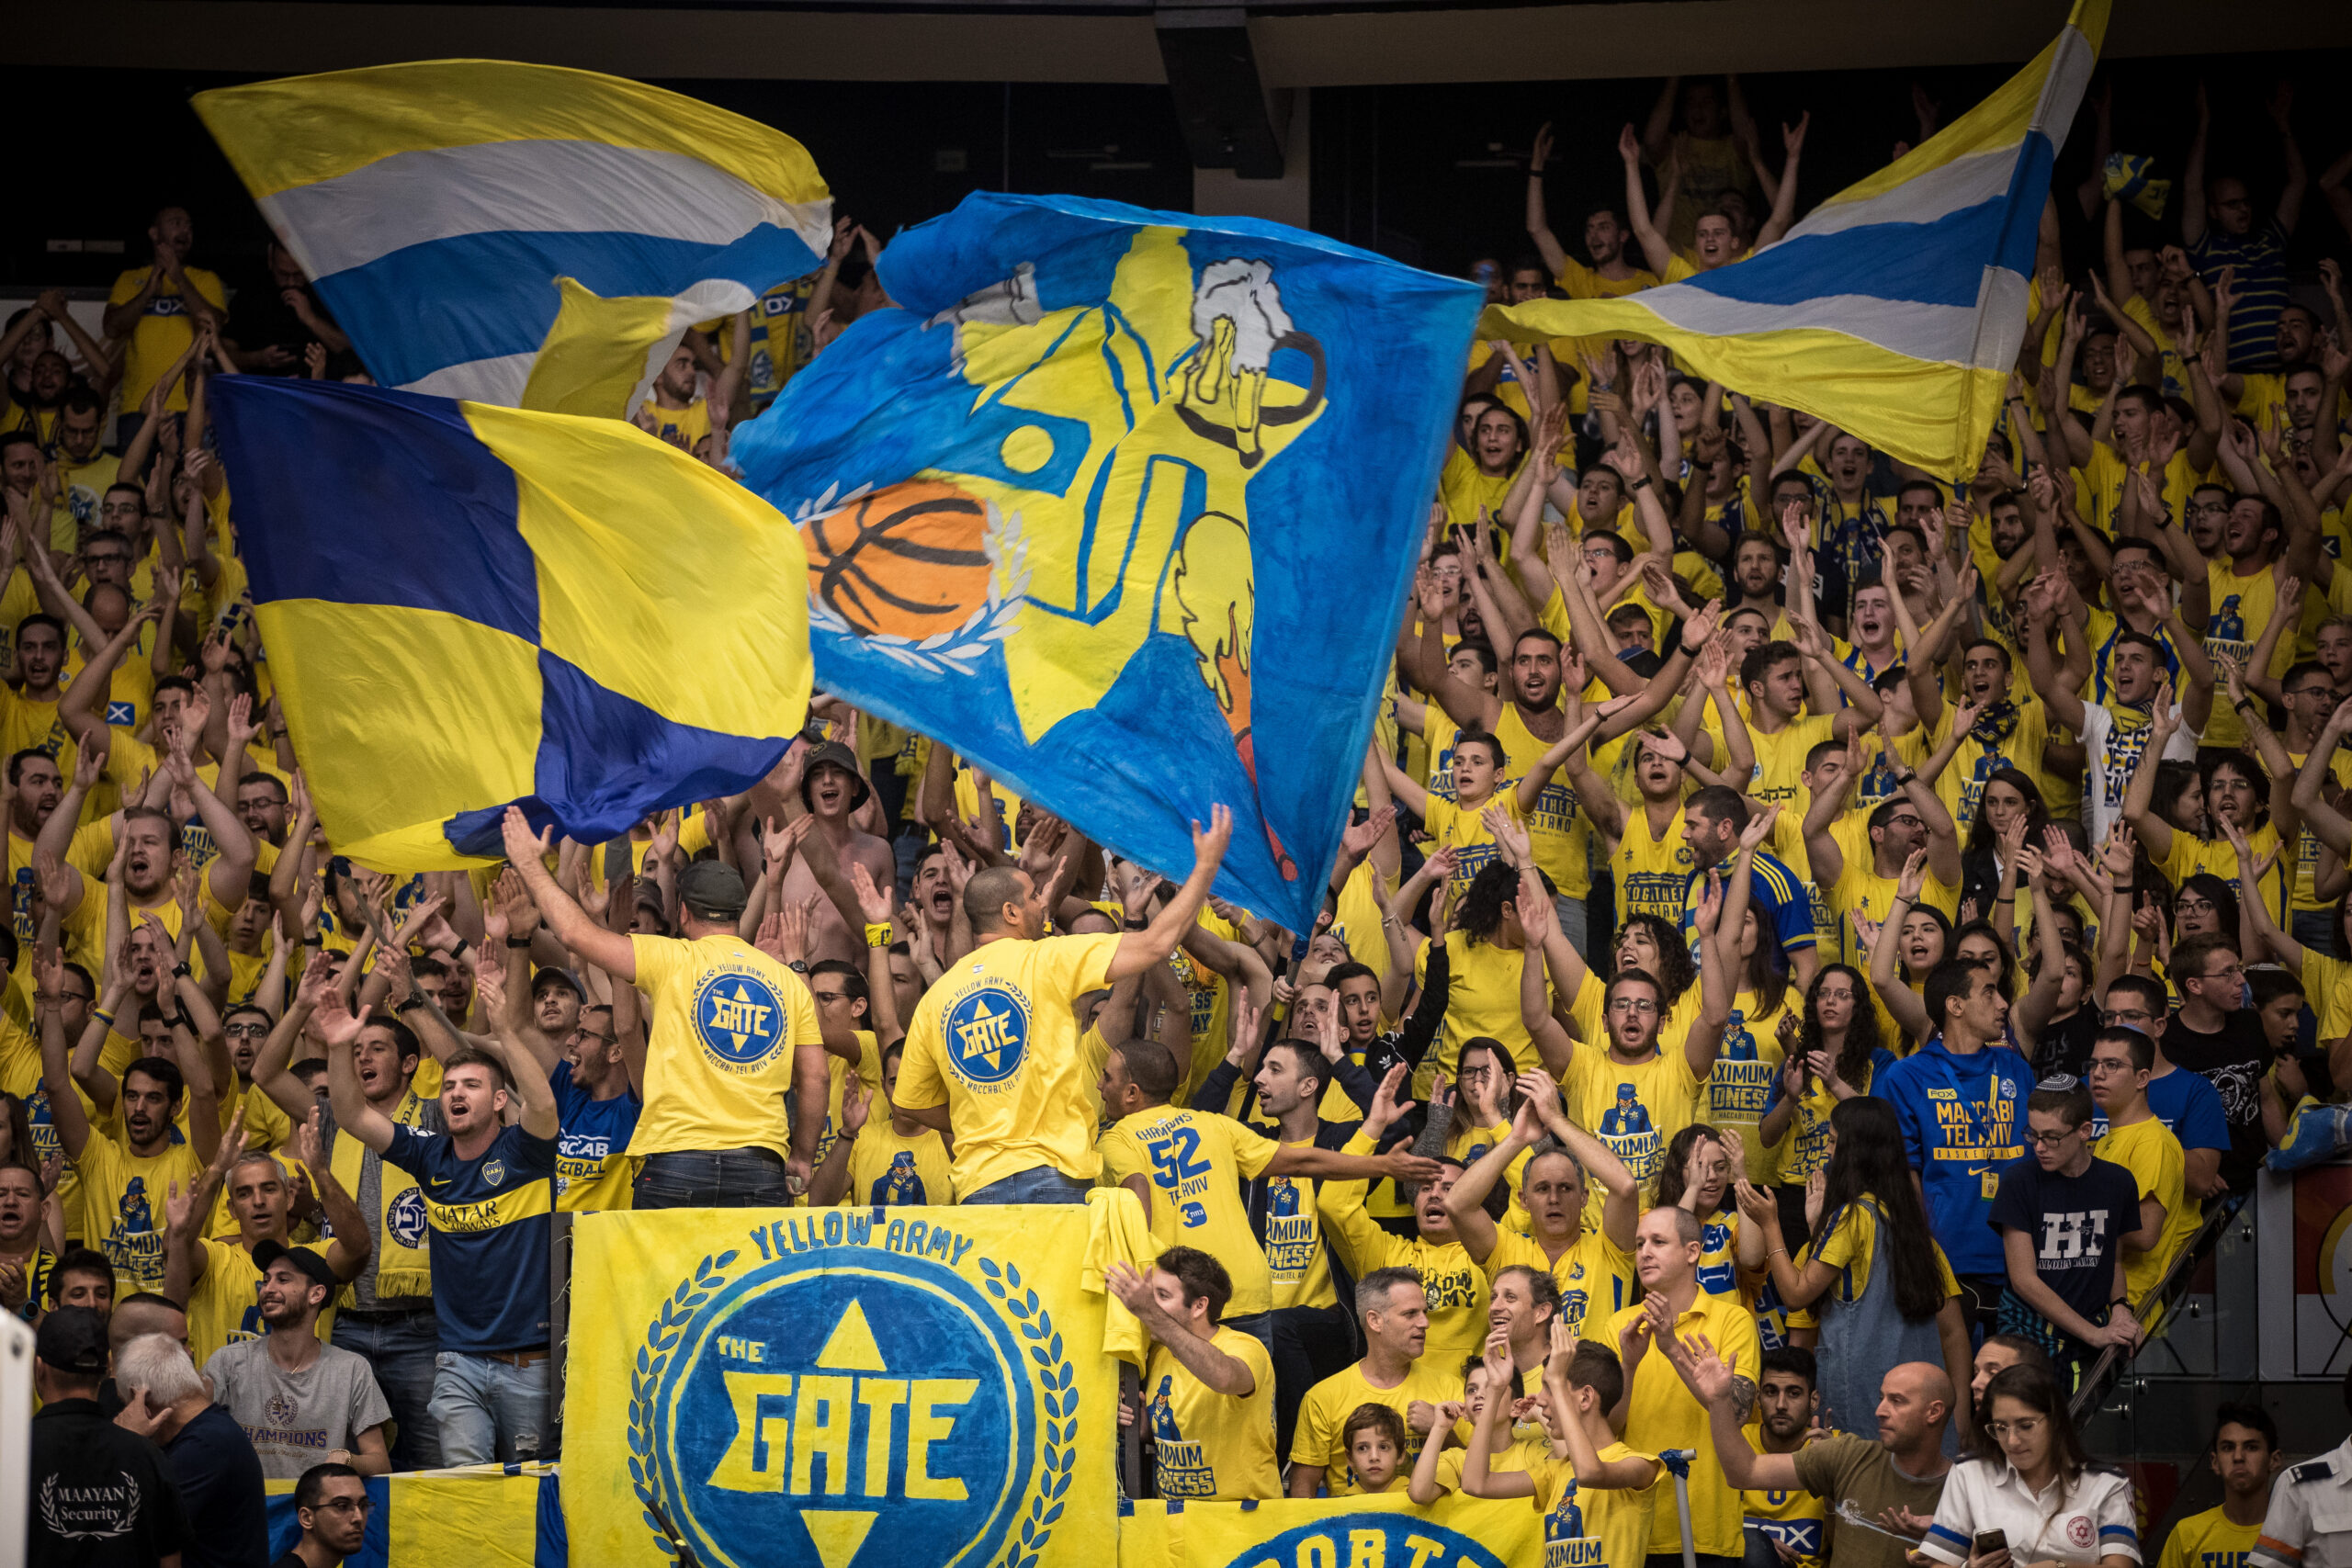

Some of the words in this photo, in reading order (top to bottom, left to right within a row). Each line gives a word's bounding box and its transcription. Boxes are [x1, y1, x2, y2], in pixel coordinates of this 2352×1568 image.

[712, 988, 725, 997] THE
[708, 996, 772, 1037] GATE
[956, 1009, 1020, 1060] GATE
[1930, 1089, 1955, 1098] FOX
[1595, 1129, 1662, 1156] AXIMUM
[1941, 1124, 1974, 1145] TEL
[1148, 1127, 1212, 1189] 52
[1182, 1176, 1208, 1198] AVIV
[435, 1201, 498, 1224] QATAR
[450, 1216, 501, 1233] AIRWAYS
[749, 1211, 874, 1260] YELLOW
[885, 1218, 974, 1267] ARMY
[2040, 1210, 2109, 1259] HI
[716, 1335, 764, 1363] THE
[242, 1426, 328, 1450] HAMPIONS
[706, 1371, 980, 1501] GATE
[58, 1487, 125, 1502] MAAYAN
[61, 1506, 121, 1525] Security
[1546, 1541, 1601, 1567] XIMUM
